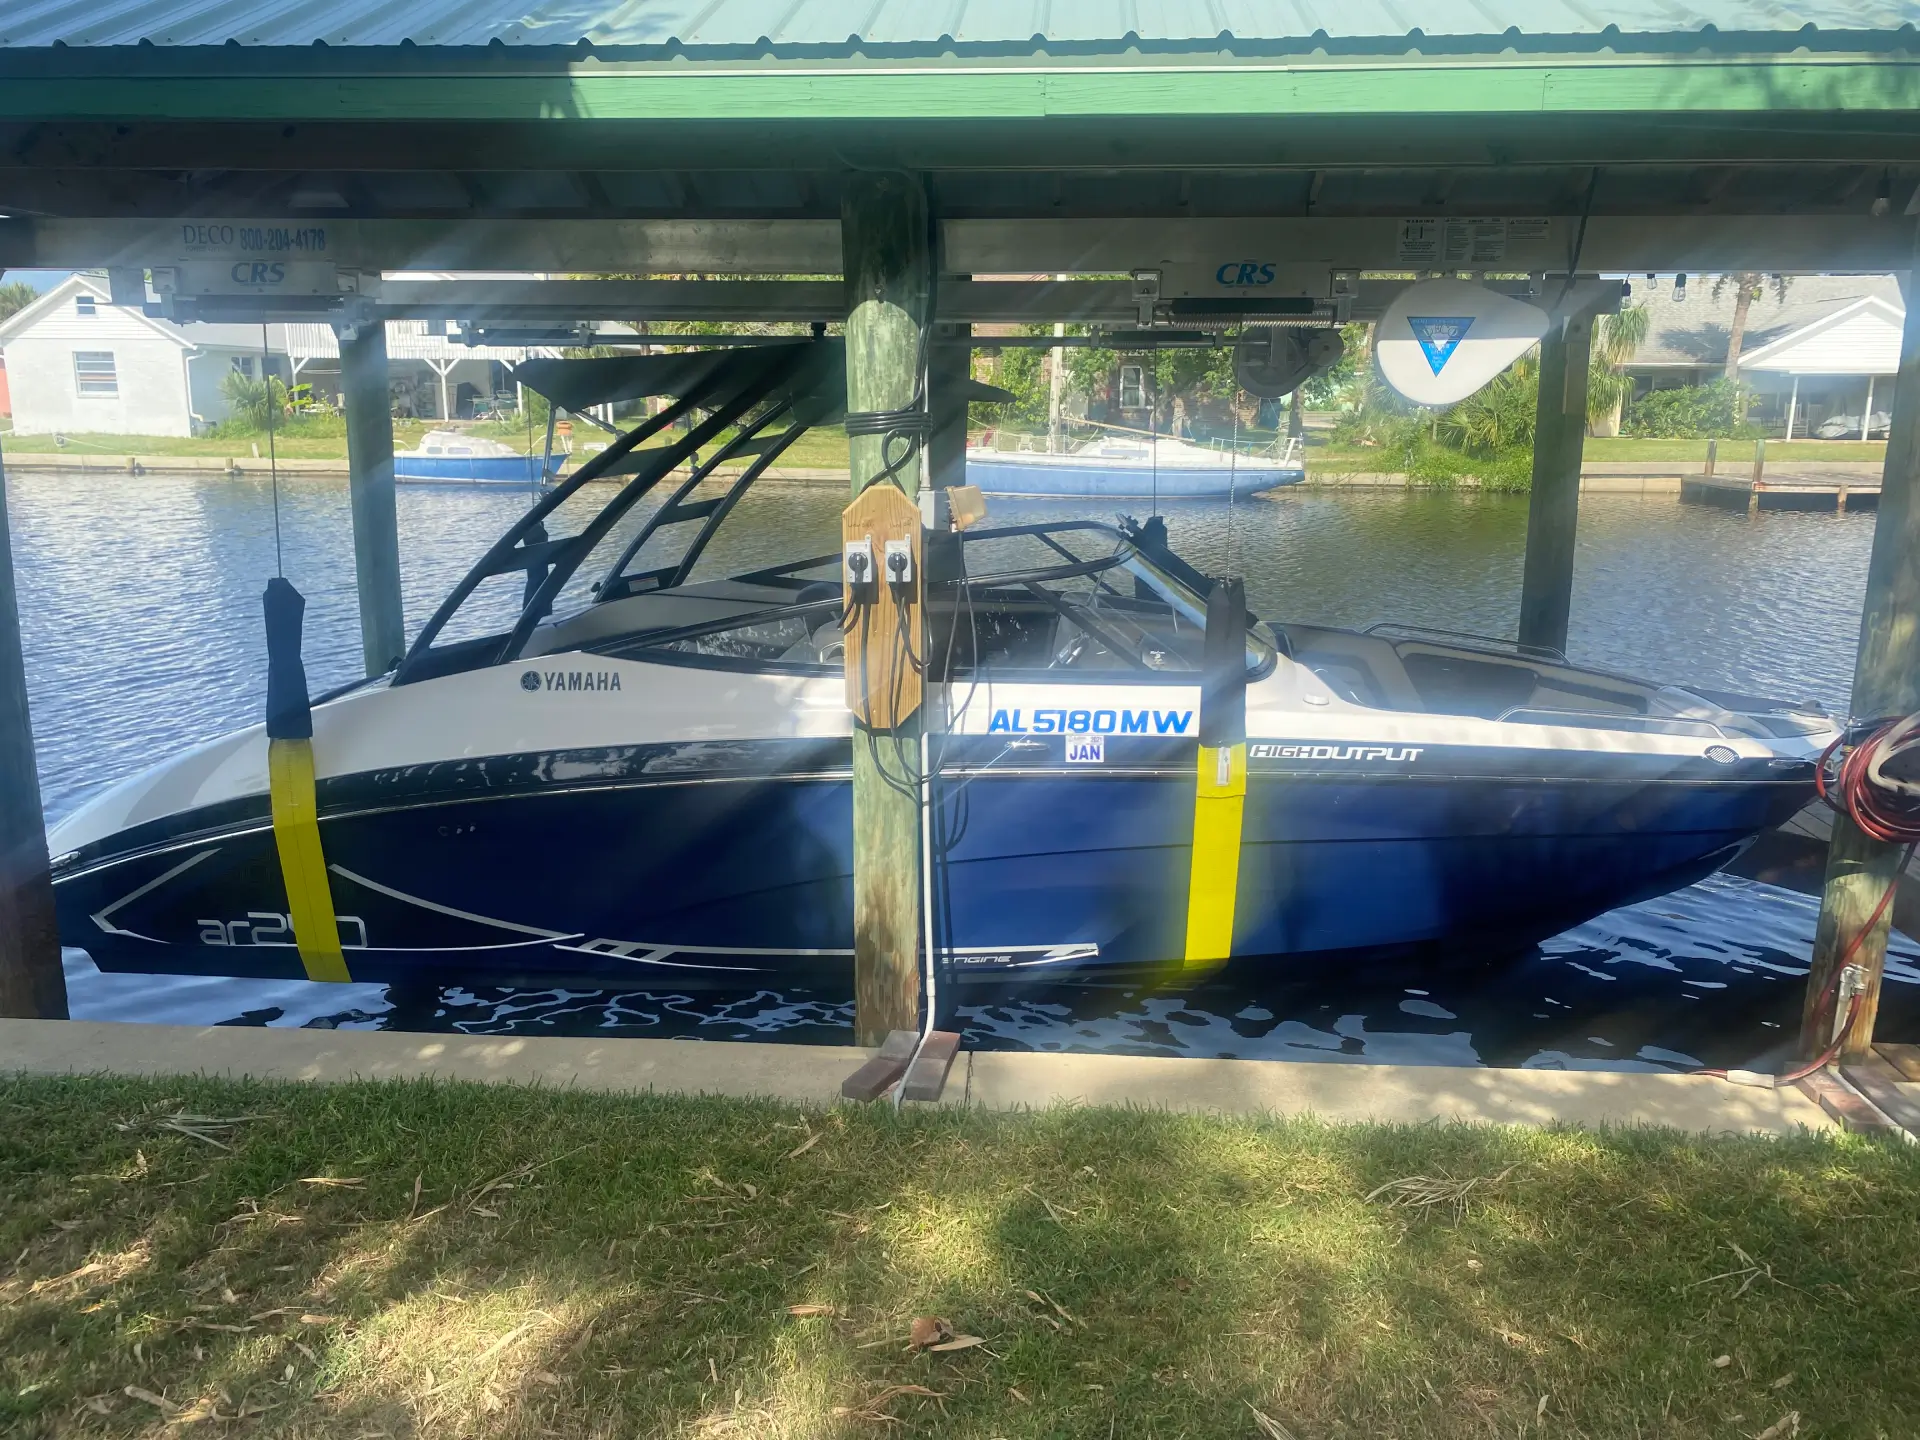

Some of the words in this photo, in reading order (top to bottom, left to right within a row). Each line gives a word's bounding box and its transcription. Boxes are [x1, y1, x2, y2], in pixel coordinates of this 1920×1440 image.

[182, 225, 233, 245] DECO
[239, 228, 326, 251] 800-204-4178
[231, 262, 285, 283] CRS
[1216, 263, 1276, 284] CRS
[544, 672, 621, 691] YAMAHA
[1070, 745, 1100, 760] JAN
[197, 912, 368, 948] ar20
